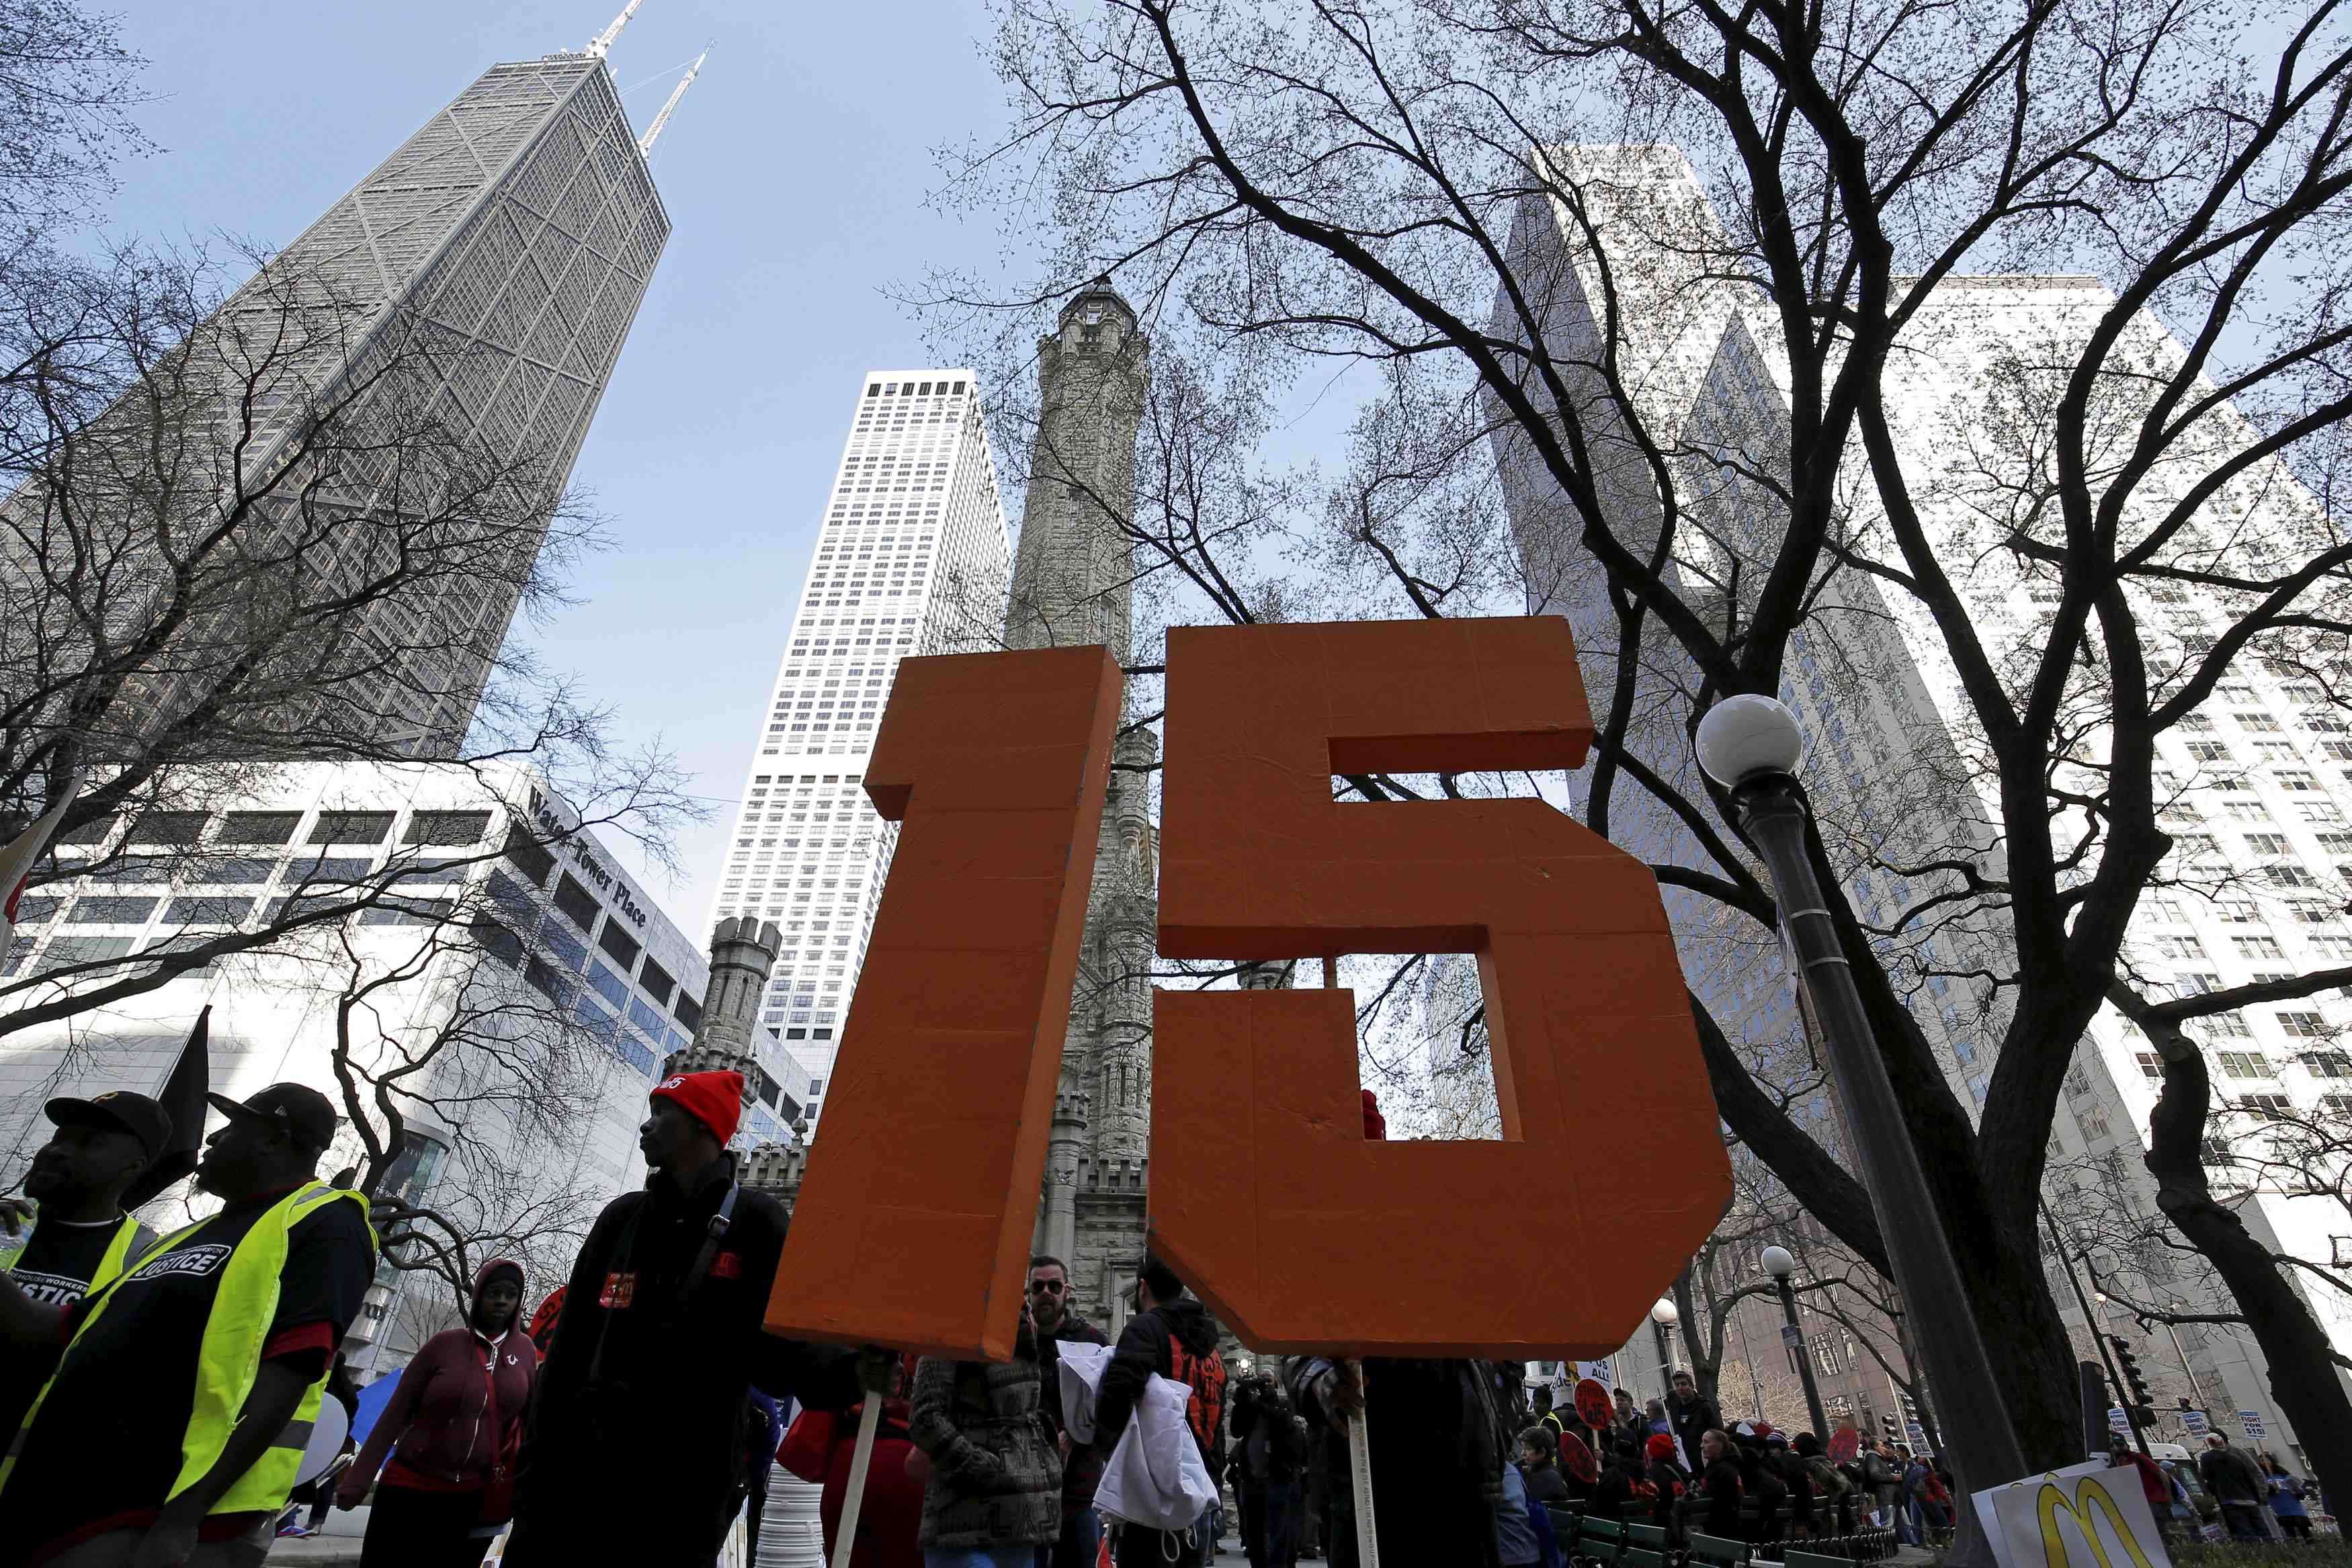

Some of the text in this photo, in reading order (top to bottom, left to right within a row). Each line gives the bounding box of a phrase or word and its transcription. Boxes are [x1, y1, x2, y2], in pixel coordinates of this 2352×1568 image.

[528, 785, 646, 928] Wate Tower Place
[765, 615, 1734, 1361] 15
[134, 1253, 218, 1276] JUSTICE
[16, 1282, 81, 1307] STIC
[1591, 1368, 1610, 1383] ALL!
